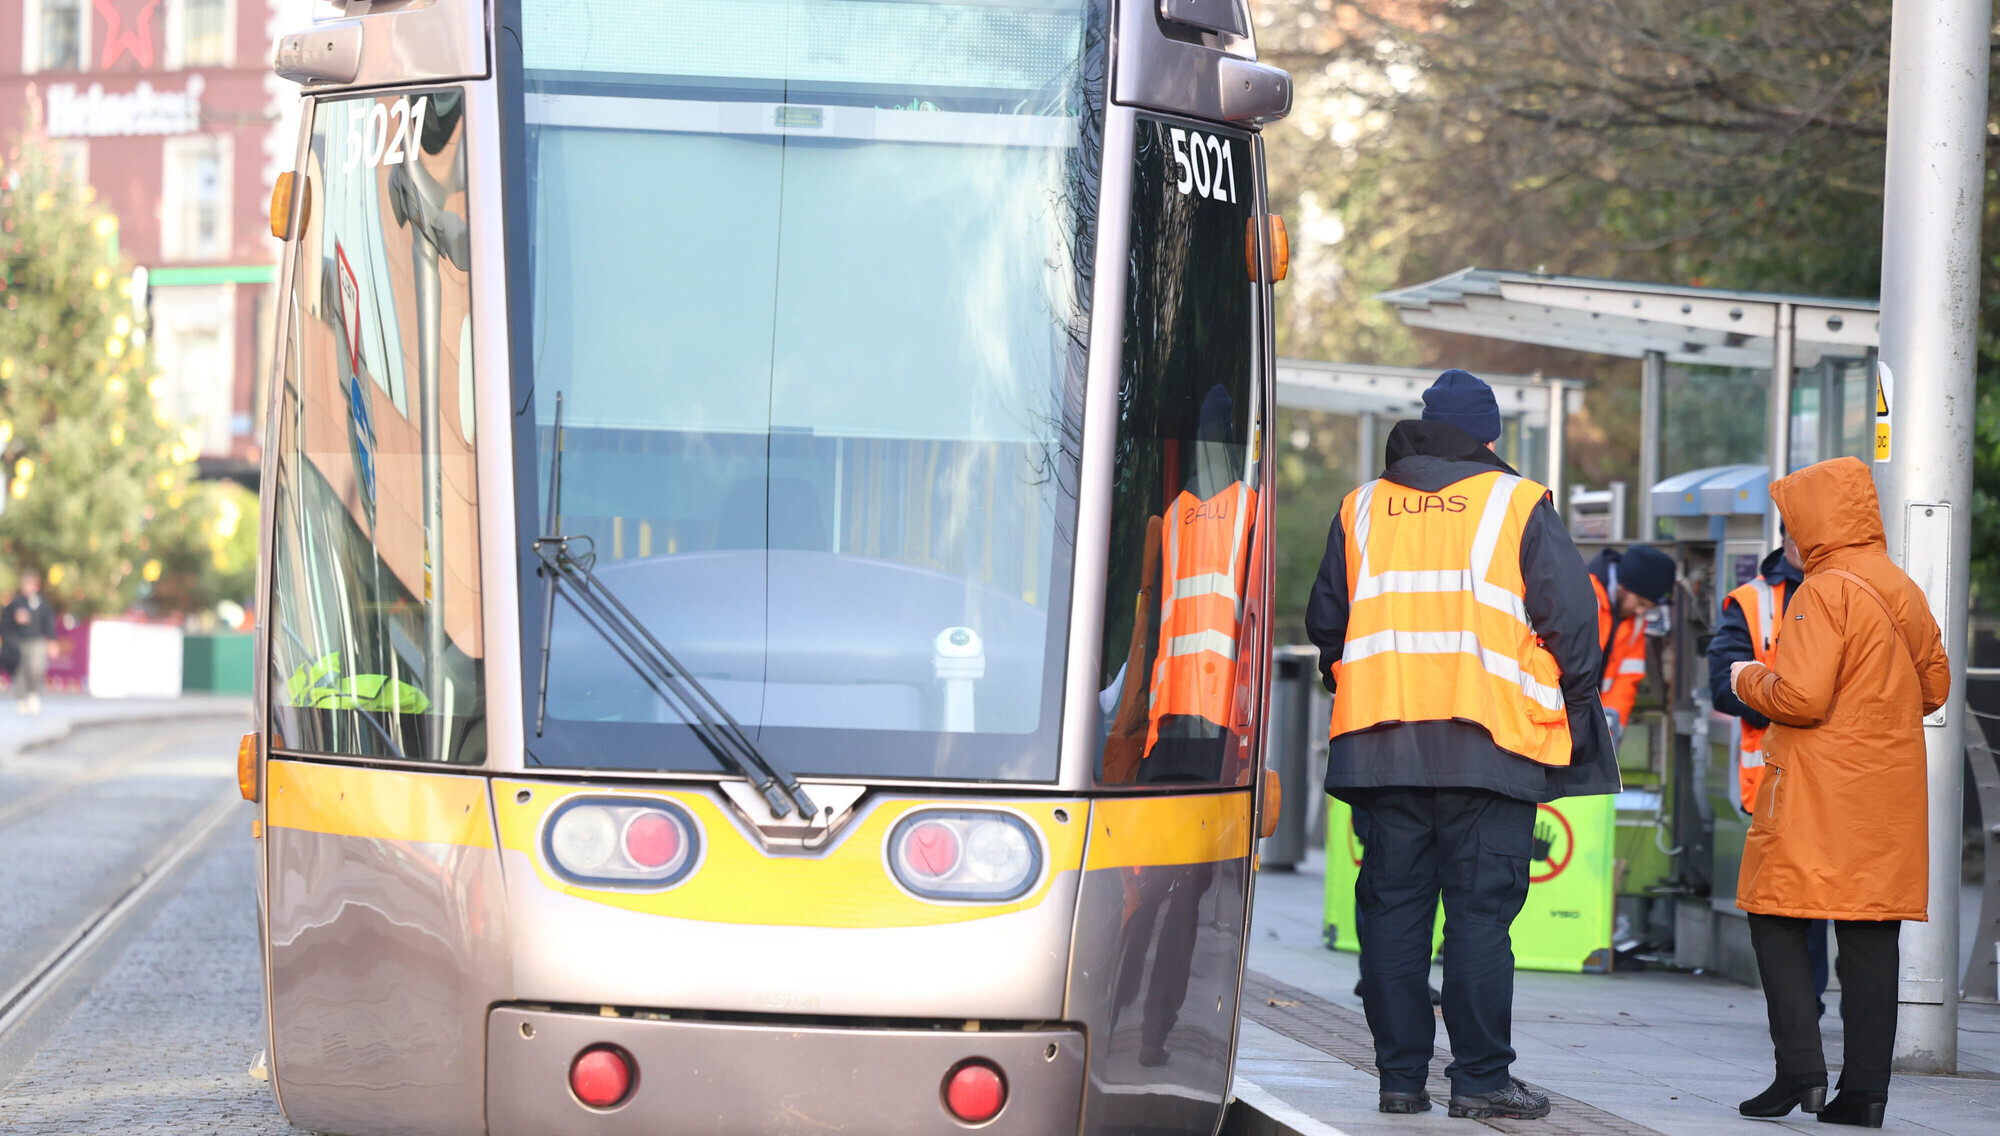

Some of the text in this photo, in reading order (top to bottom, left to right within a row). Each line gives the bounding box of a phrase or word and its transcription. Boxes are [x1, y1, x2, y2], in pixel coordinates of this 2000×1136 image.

[343, 96, 428, 174] 5021
[1170, 128, 1237, 205] 5021
[1388, 495, 1468, 517] LUAS
